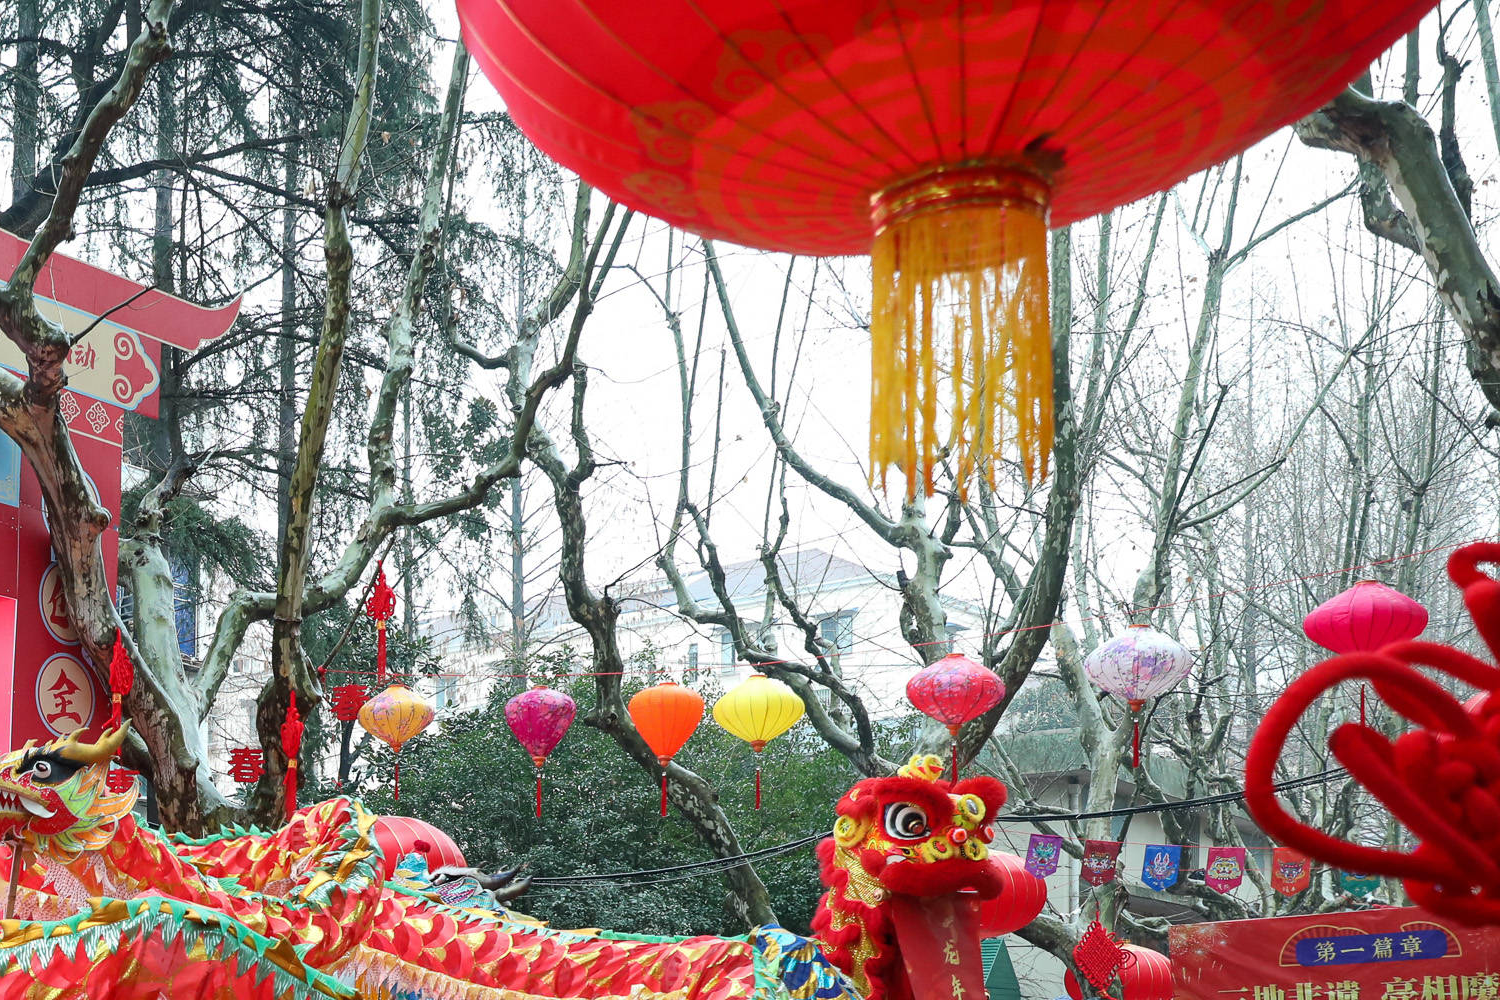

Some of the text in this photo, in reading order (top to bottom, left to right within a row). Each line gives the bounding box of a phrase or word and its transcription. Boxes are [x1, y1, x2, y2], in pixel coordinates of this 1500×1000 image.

[329, 684, 370, 722] 春
[228, 747, 266, 783] 春
[1314, 934, 1424, 963] 第一篇章
